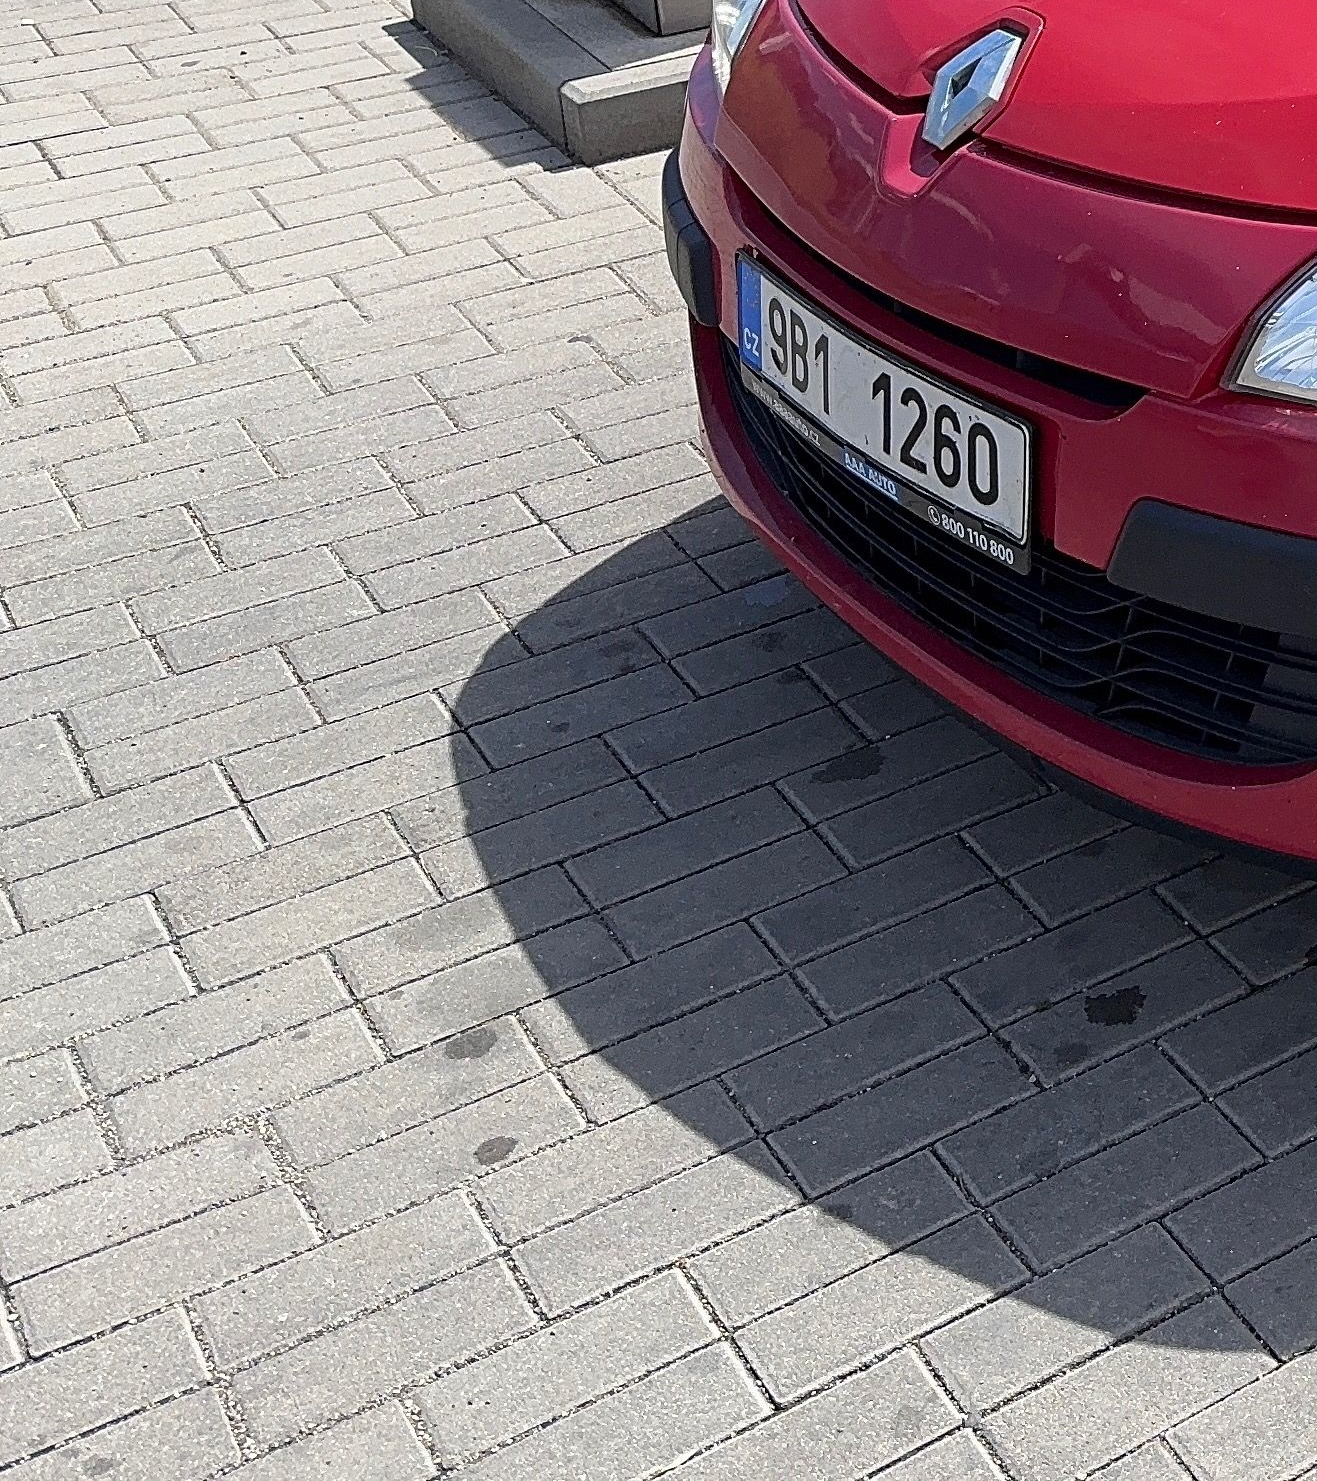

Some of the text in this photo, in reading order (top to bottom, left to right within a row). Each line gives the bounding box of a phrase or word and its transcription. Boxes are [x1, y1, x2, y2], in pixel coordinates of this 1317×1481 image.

[743, 327, 760, 358] CZ
[768, 297, 1000, 507] 9B1 1260
[843, 452, 898, 496] AAA AUTO
[941, 513, 1014, 566] 800 110 800
